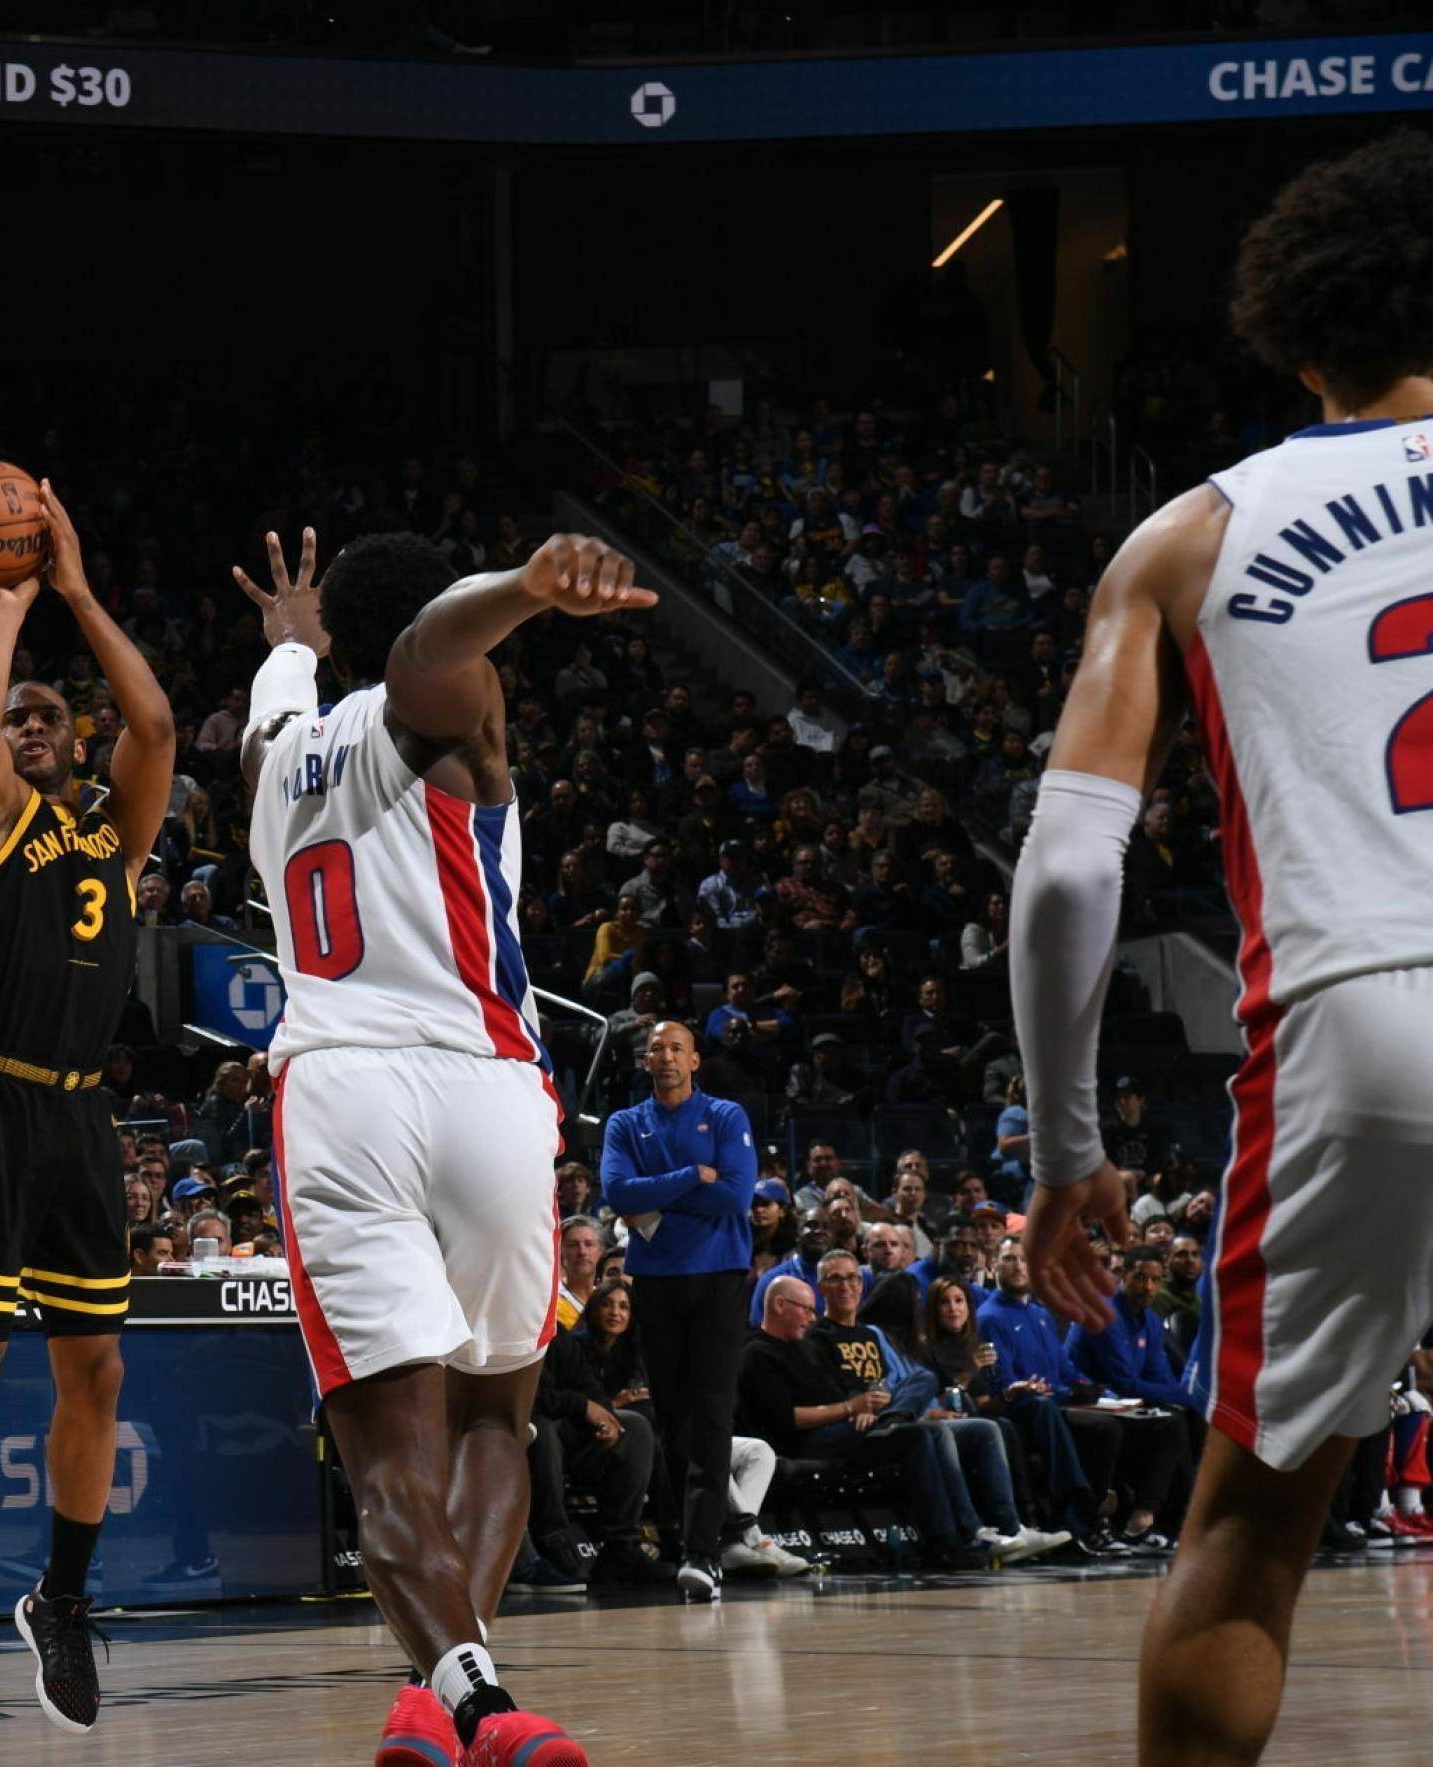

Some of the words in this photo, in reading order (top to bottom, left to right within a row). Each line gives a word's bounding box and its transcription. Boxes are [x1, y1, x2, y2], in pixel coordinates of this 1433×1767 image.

[50, 63, 132, 108] $30
[1208, 55, 1376, 101] CHASE
[1391, 52, 1433, 93] C
[23, 830, 65, 874] SAN
[70, 877, 107, 942] 3
[283, 838, 366, 982] 0
[221, 1281, 299, 1312] CHAS
[837, 1341, 880, 1361] BOO
